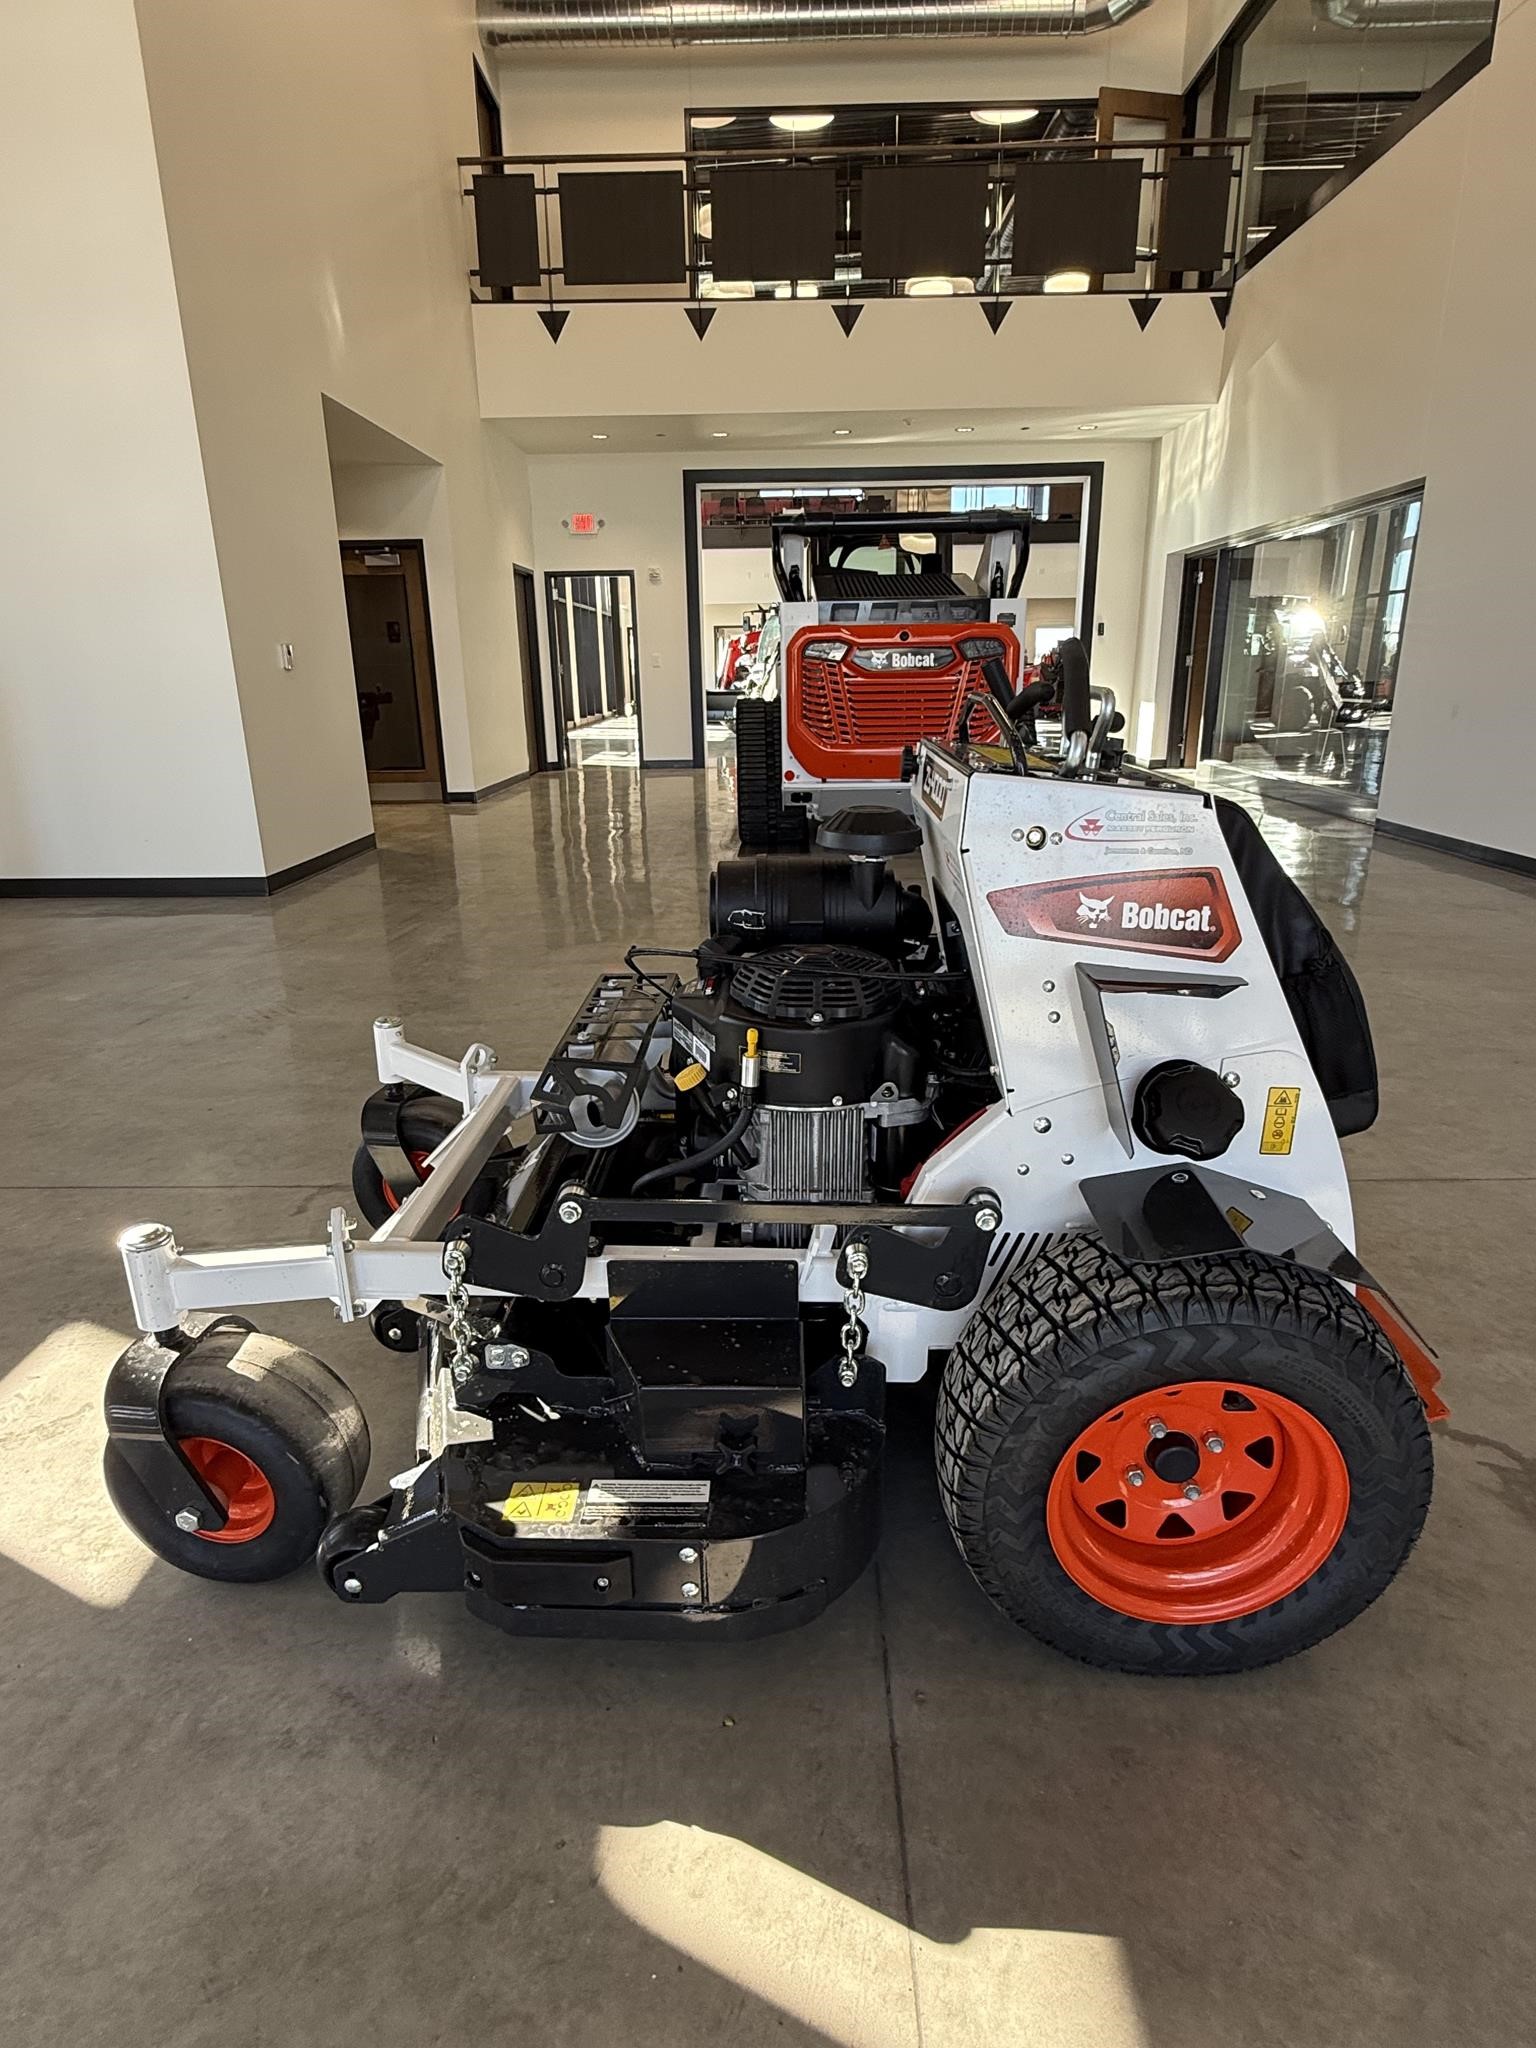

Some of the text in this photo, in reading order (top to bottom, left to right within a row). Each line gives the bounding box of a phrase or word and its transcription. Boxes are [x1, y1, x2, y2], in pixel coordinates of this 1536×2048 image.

[892, 653, 935, 668] Bobcat
[1105, 809, 1146, 822] Central
[1121, 901, 1212, 932] Bobcat
